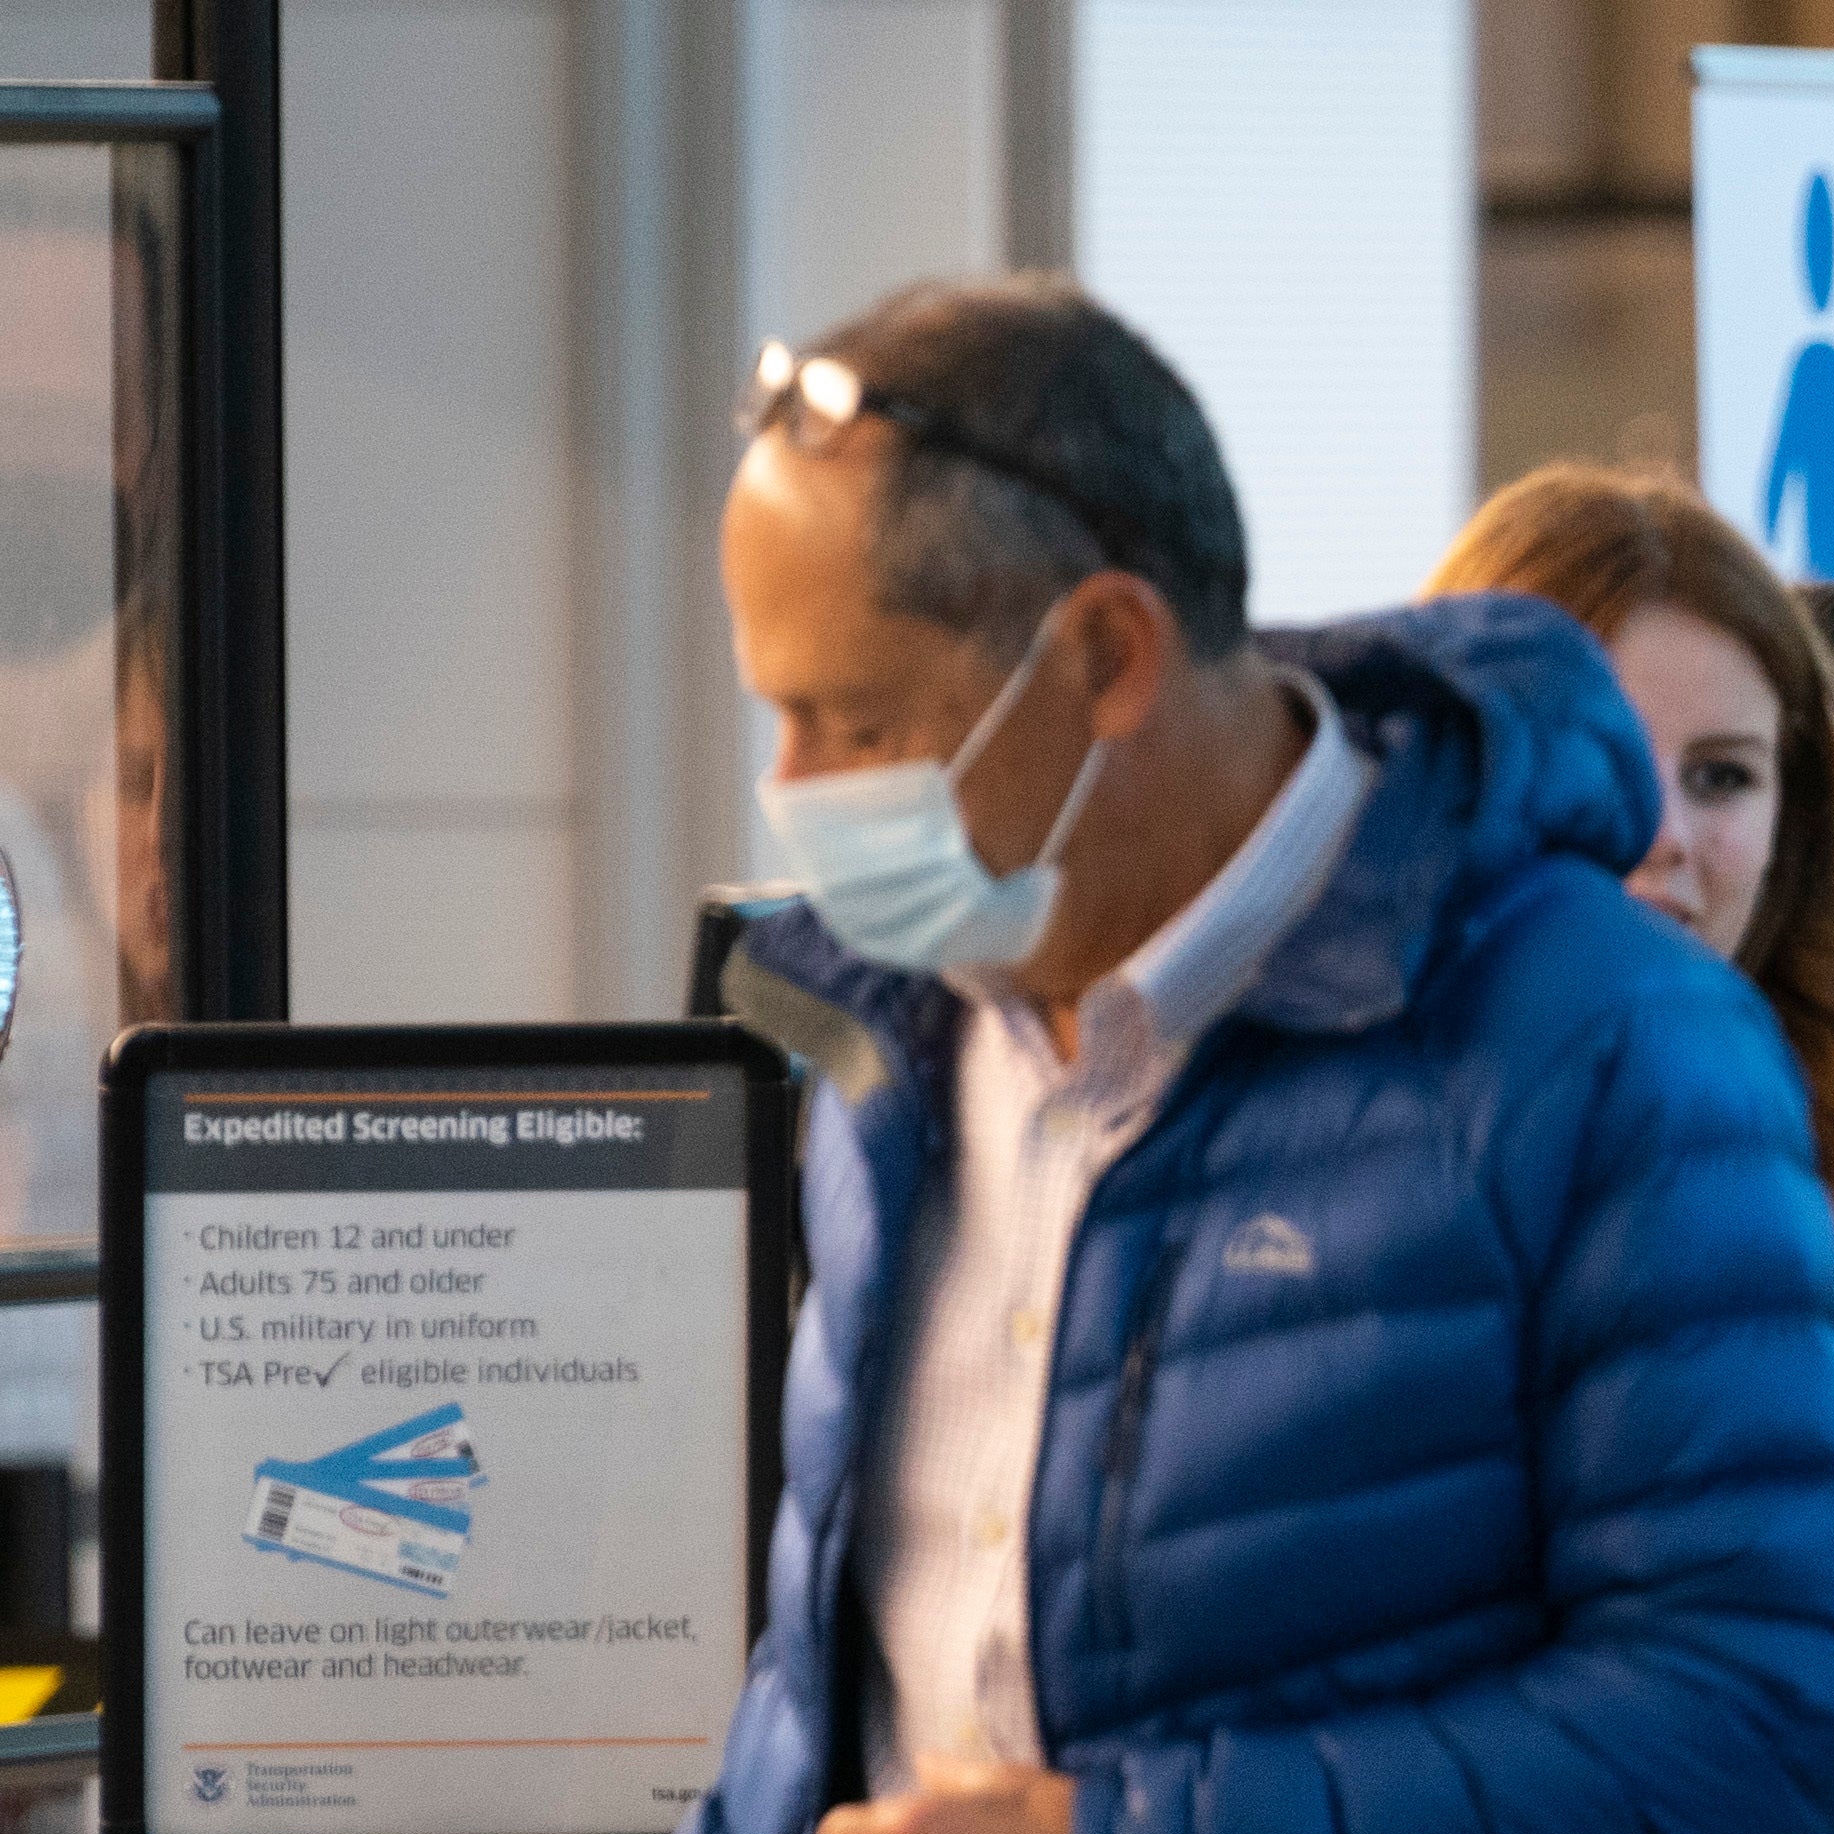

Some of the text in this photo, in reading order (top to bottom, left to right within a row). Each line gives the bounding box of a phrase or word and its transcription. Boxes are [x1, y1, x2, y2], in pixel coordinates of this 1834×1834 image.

[184, 1109, 643, 1146] Expedited Screening Eligible:
[200, 1222, 517, 1251] Children 12 and under
[200, 1267, 486, 1297] Adults 75 and older
[200, 1312, 539, 1343] U.S. military in uniform
[200, 1360, 255, 1387] TSA
[360, 1358, 468, 1389] eligible
[477, 1356, 640, 1385] individuals
[184, 1618, 237, 1647] Can
[244, 1617, 322, 1646] leave
[329, 1621, 367, 1645] on
[374, 1616, 438, 1649] light
[184, 1649, 529, 1681] footwear and headwear.
